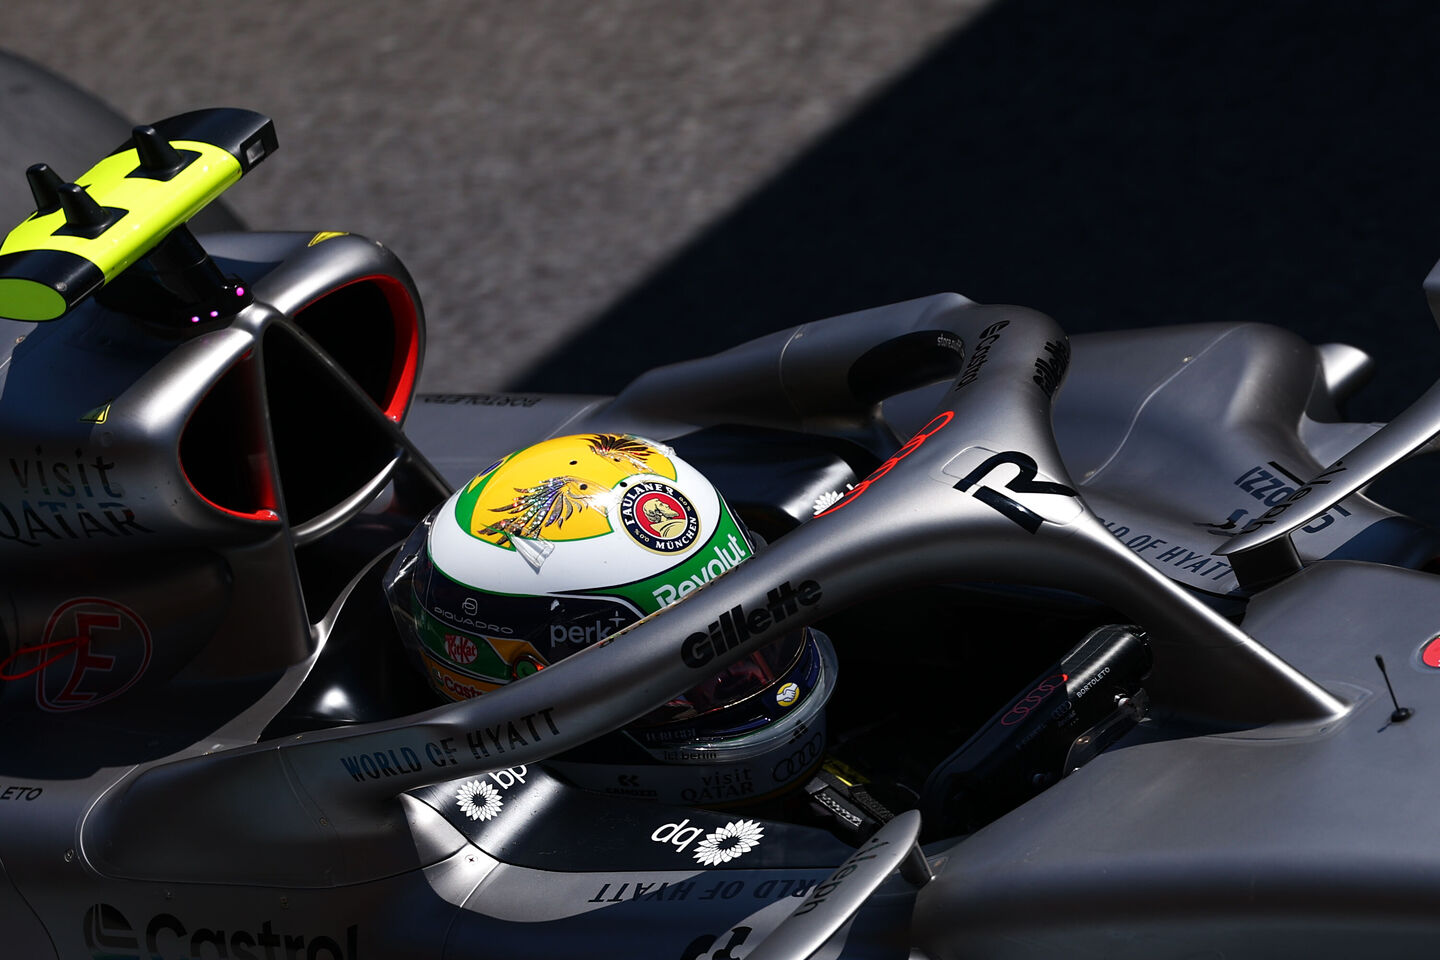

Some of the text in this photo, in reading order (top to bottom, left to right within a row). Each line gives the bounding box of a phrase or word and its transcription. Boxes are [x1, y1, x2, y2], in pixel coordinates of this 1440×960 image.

[9, 446, 121, 497] visit
[655, 517, 698, 549] MÜNCHEN
[1127, 534, 1167, 552] OF
[652, 533, 746, 608] Revolut
[681, 580, 822, 668] Gillette
[443, 676, 487, 699] Castr
[1076, 666, 1111, 698] BORTOLETO
[340, 707, 559, 782] WORLD OF HYATT
[702, 768, 752, 786] visit
[0, 786, 42, 801] ETO
[681, 781, 755, 802] QATAR
[588, 881, 696, 903] HYATT
[699, 880, 745, 901] OF
